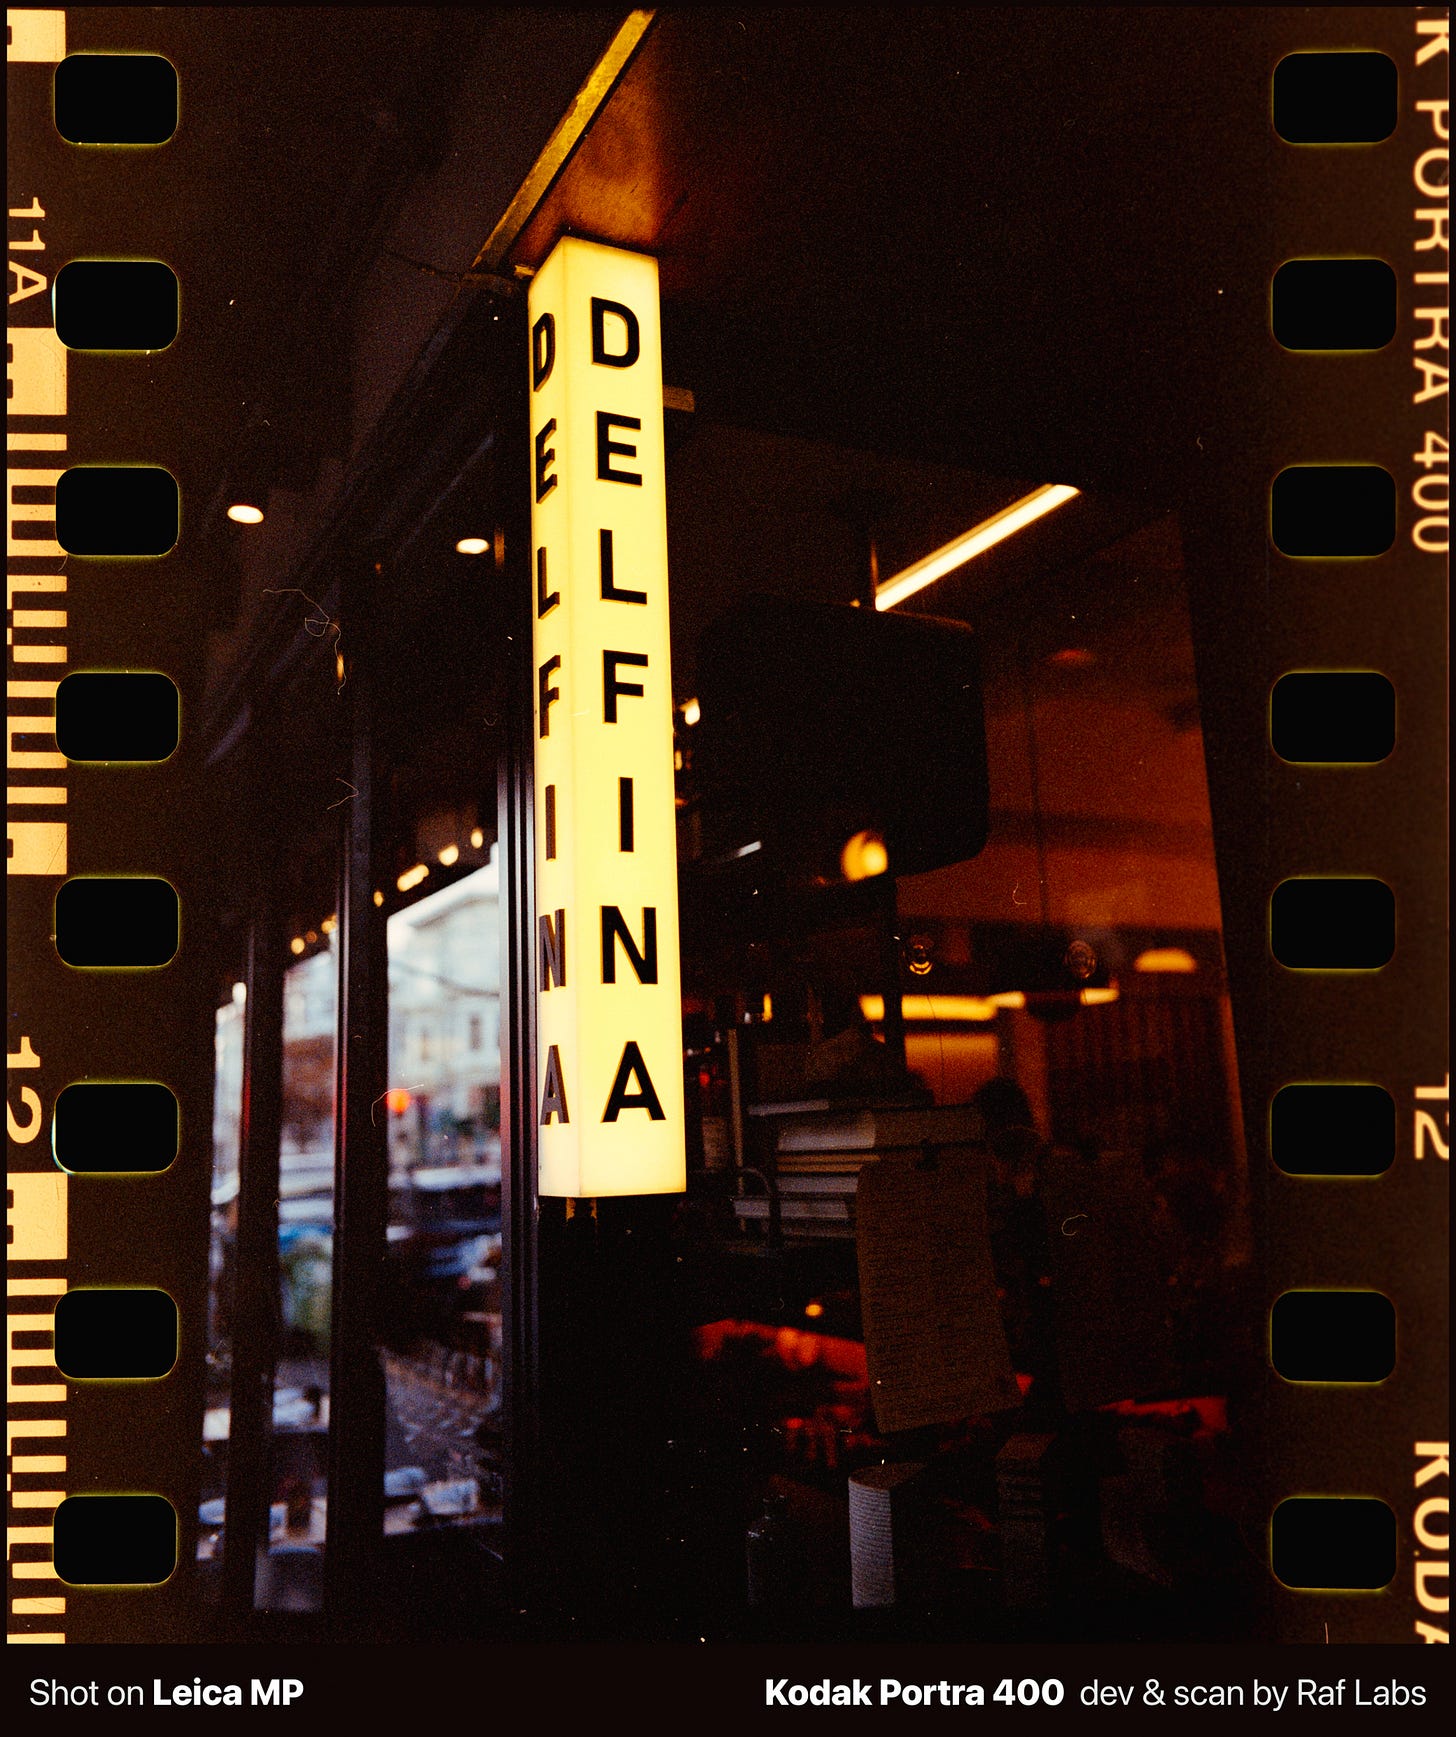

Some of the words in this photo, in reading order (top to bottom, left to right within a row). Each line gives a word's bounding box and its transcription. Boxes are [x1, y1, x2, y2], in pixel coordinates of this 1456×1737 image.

[8, 196, 48, 305] 11A
[1411, 429, 1450, 554] 400
[532, 312, 570, 1126] DELFINA
[589, 296, 666, 1123] DELFINA
[7, 1035, 43, 1144] 12
